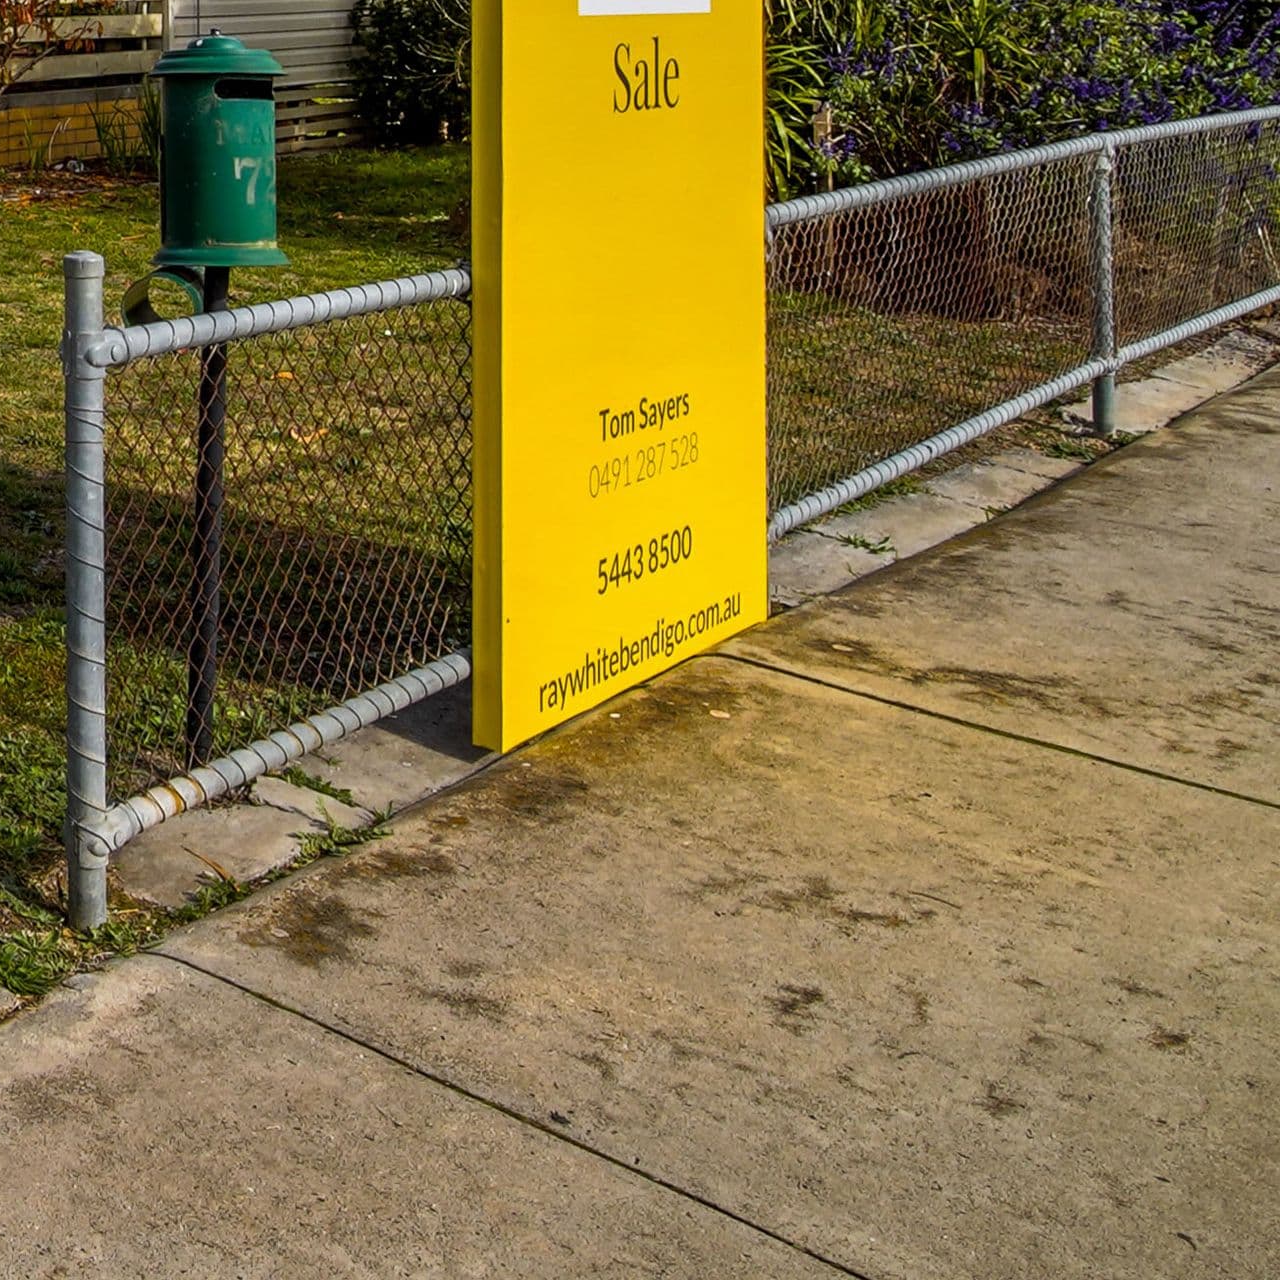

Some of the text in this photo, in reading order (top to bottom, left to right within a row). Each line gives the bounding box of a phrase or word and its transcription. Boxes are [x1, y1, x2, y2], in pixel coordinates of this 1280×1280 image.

[613, 36, 680, 113] Sale
[599, 393, 690, 441] Tom Sayers
[589, 431, 699, 498] 0491 287 528
[597, 525, 692, 595] 5443 8500
[539, 592, 741, 712] raywhitebendigo.com.au
